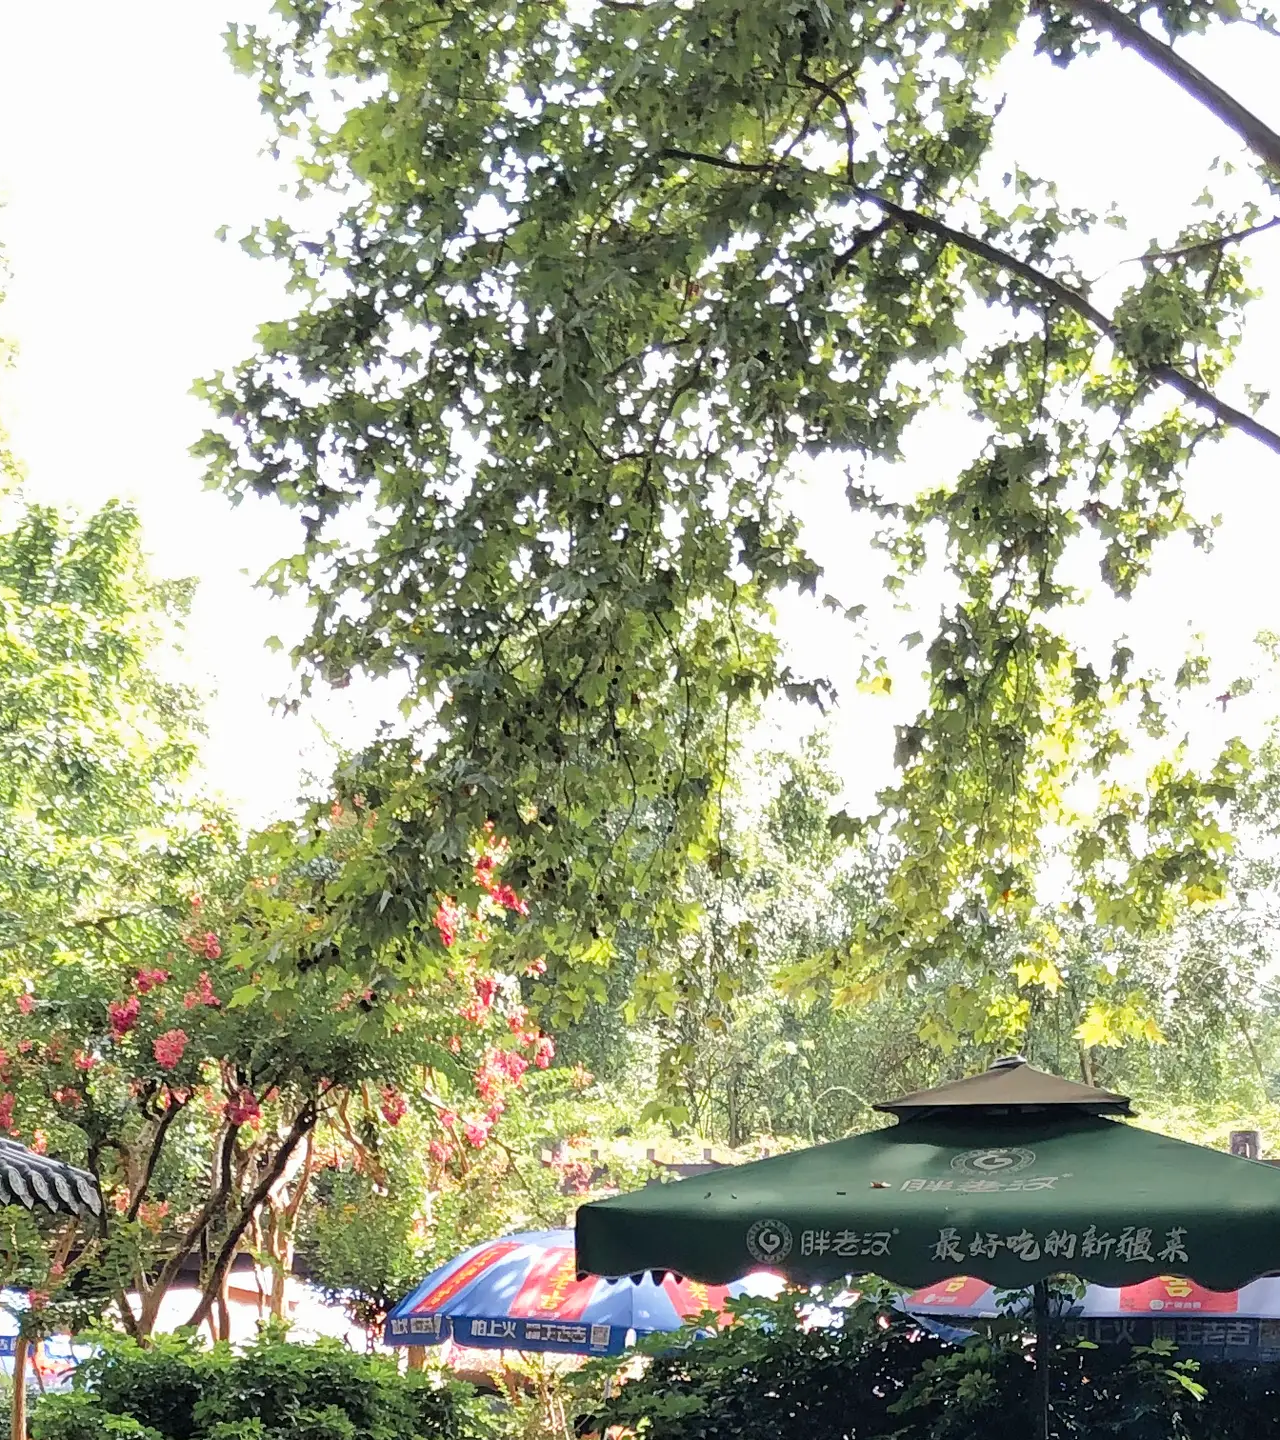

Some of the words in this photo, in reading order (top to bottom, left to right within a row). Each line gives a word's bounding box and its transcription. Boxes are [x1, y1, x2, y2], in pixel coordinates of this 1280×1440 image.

[800, 1230, 892, 1257] 胖老汉
[930, 1223, 1190, 1263] 最好吃的新疆菜
[470, 1319, 517, 1339] 怕上火
